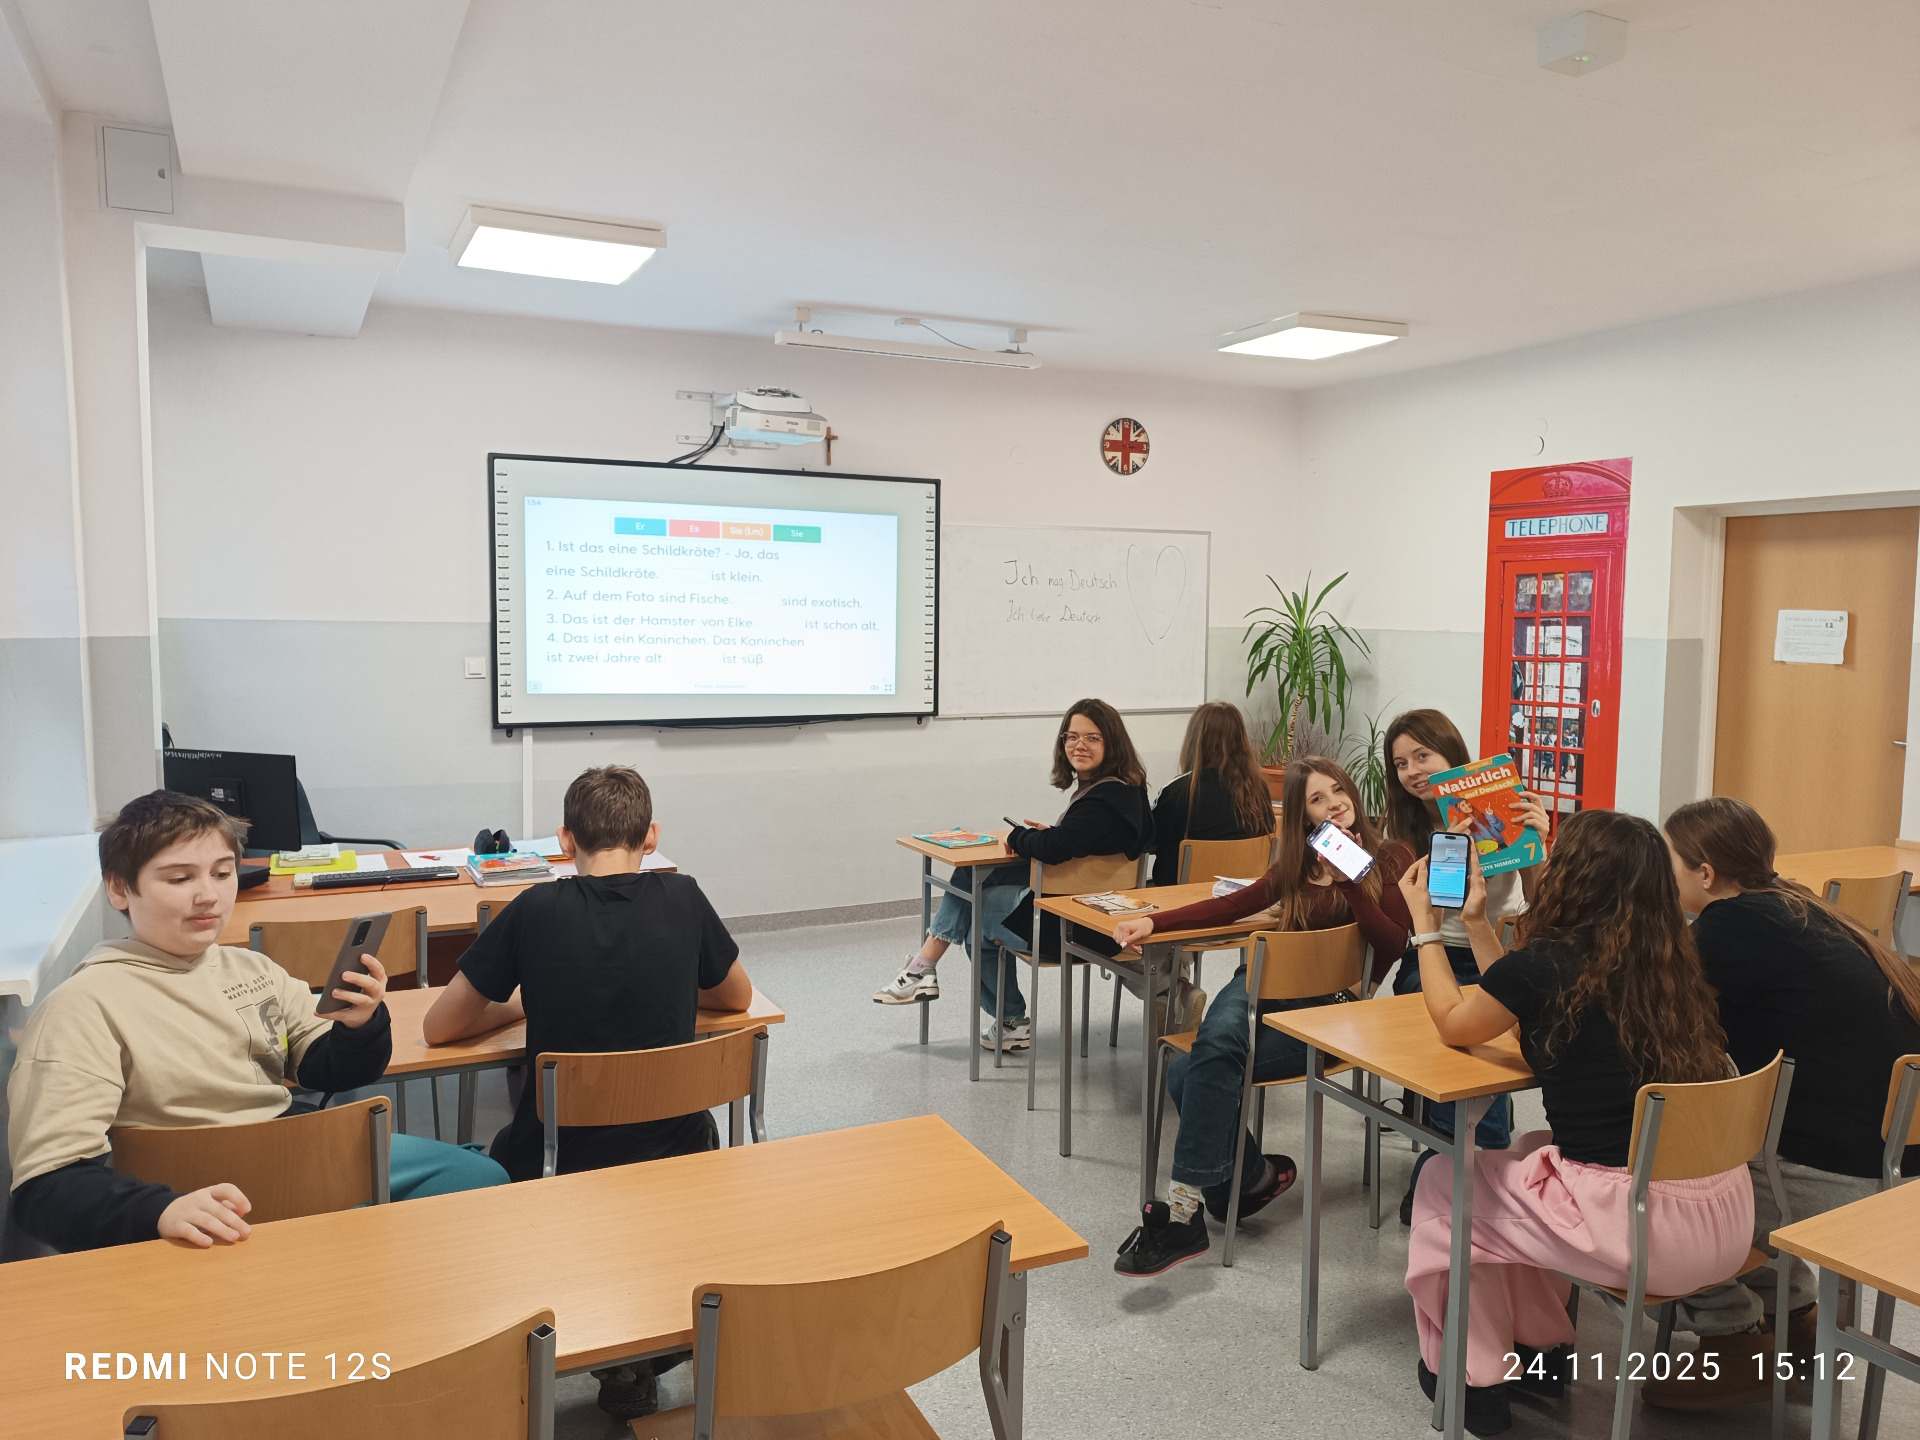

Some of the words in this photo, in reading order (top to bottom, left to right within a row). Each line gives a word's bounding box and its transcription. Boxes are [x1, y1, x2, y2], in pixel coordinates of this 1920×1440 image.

[635, 522, 645, 531] Er
[689, 525, 700, 533] Es
[729, 526, 743, 535] Sie
[790, 529, 804, 538] Sie
[1508, 515, 1605, 537] TELEPHONE
[545, 540, 555, 551] 1.
[558, 540, 575, 552] Ist
[579, 541, 604, 553] das
[608, 543, 638, 554] eine
[642, 544, 721, 557] Schildkröte?
[734, 547, 753, 559] Ja,
[756, 549, 780, 560] das
[545, 565, 576, 576] eine
[580, 565, 659, 579] Schildkröte.
[711, 570, 727, 581] ist
[729, 570, 763, 582] klein.
[1048, 577, 1064, 597] mag
[1069, 569, 1117, 591] Deutsch
[545, 588, 558, 600] 2.
[562, 589, 588, 600] Auf
[592, 589, 623, 601] dem
[625, 590, 655, 602] Foto
[658, 592, 687, 603] sind
[689, 592, 732, 604] Fische.
[781, 596, 808, 606] sind
[810, 597, 863, 608] exotisch.
[546, 612, 558, 624] 3.
[562, 612, 589, 624] Das
[592, 614, 609, 624] ist
[613, 614, 636, 625] der
[640, 615, 696, 626] Hamster
[700, 618, 725, 627] von
[804, 619, 819, 629] ist
[823, 619, 858, 630] schon
[860, 620, 880, 630] alt.
[1059, 604, 1101, 624] Deutsch
[546, 632, 559, 642] 4.
[562, 632, 589, 643] Das
[593, 633, 609, 643] ist
[613, 633, 635, 643] ein
[712, 634, 737, 645] Das
[740, 636, 805, 646] Kaninchen
[546, 651, 563, 662] ist
[567, 651, 599, 662] zwei
[602, 652, 641, 663] Jahre
[722, 655, 737, 664] ist
[1437, 766, 1512, 796] Natürlich
[1463, 788, 1480, 800] auf
[1479, 779, 1516, 795] Deutsch!
[1523, 842, 1536, 861] 7
